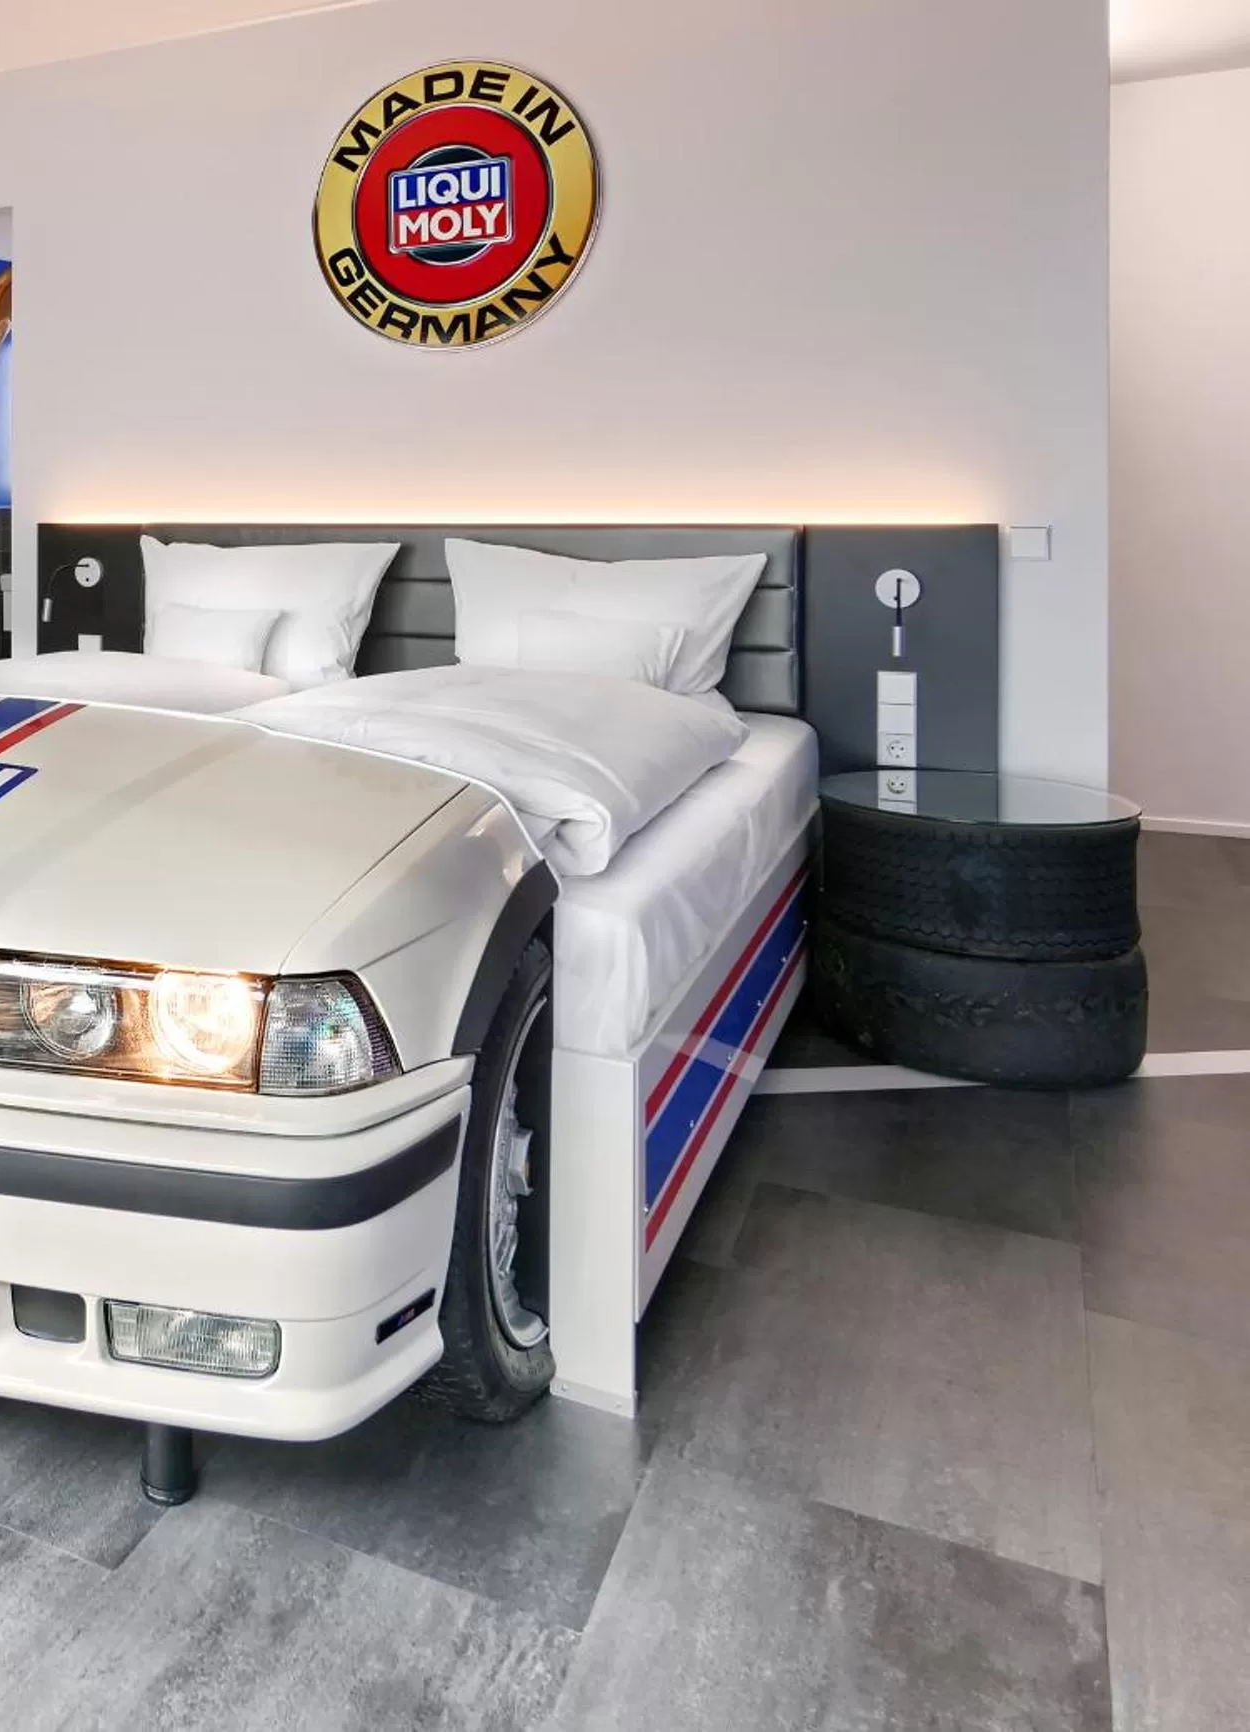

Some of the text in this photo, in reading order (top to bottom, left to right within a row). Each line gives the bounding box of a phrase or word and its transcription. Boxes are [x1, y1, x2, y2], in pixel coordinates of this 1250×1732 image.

[333, 69, 576, 172] MADE IN
[398, 165, 501, 208] LIQUI
[399, 202, 504, 244] MOLY
[328, 231, 575, 344] GERMANY
